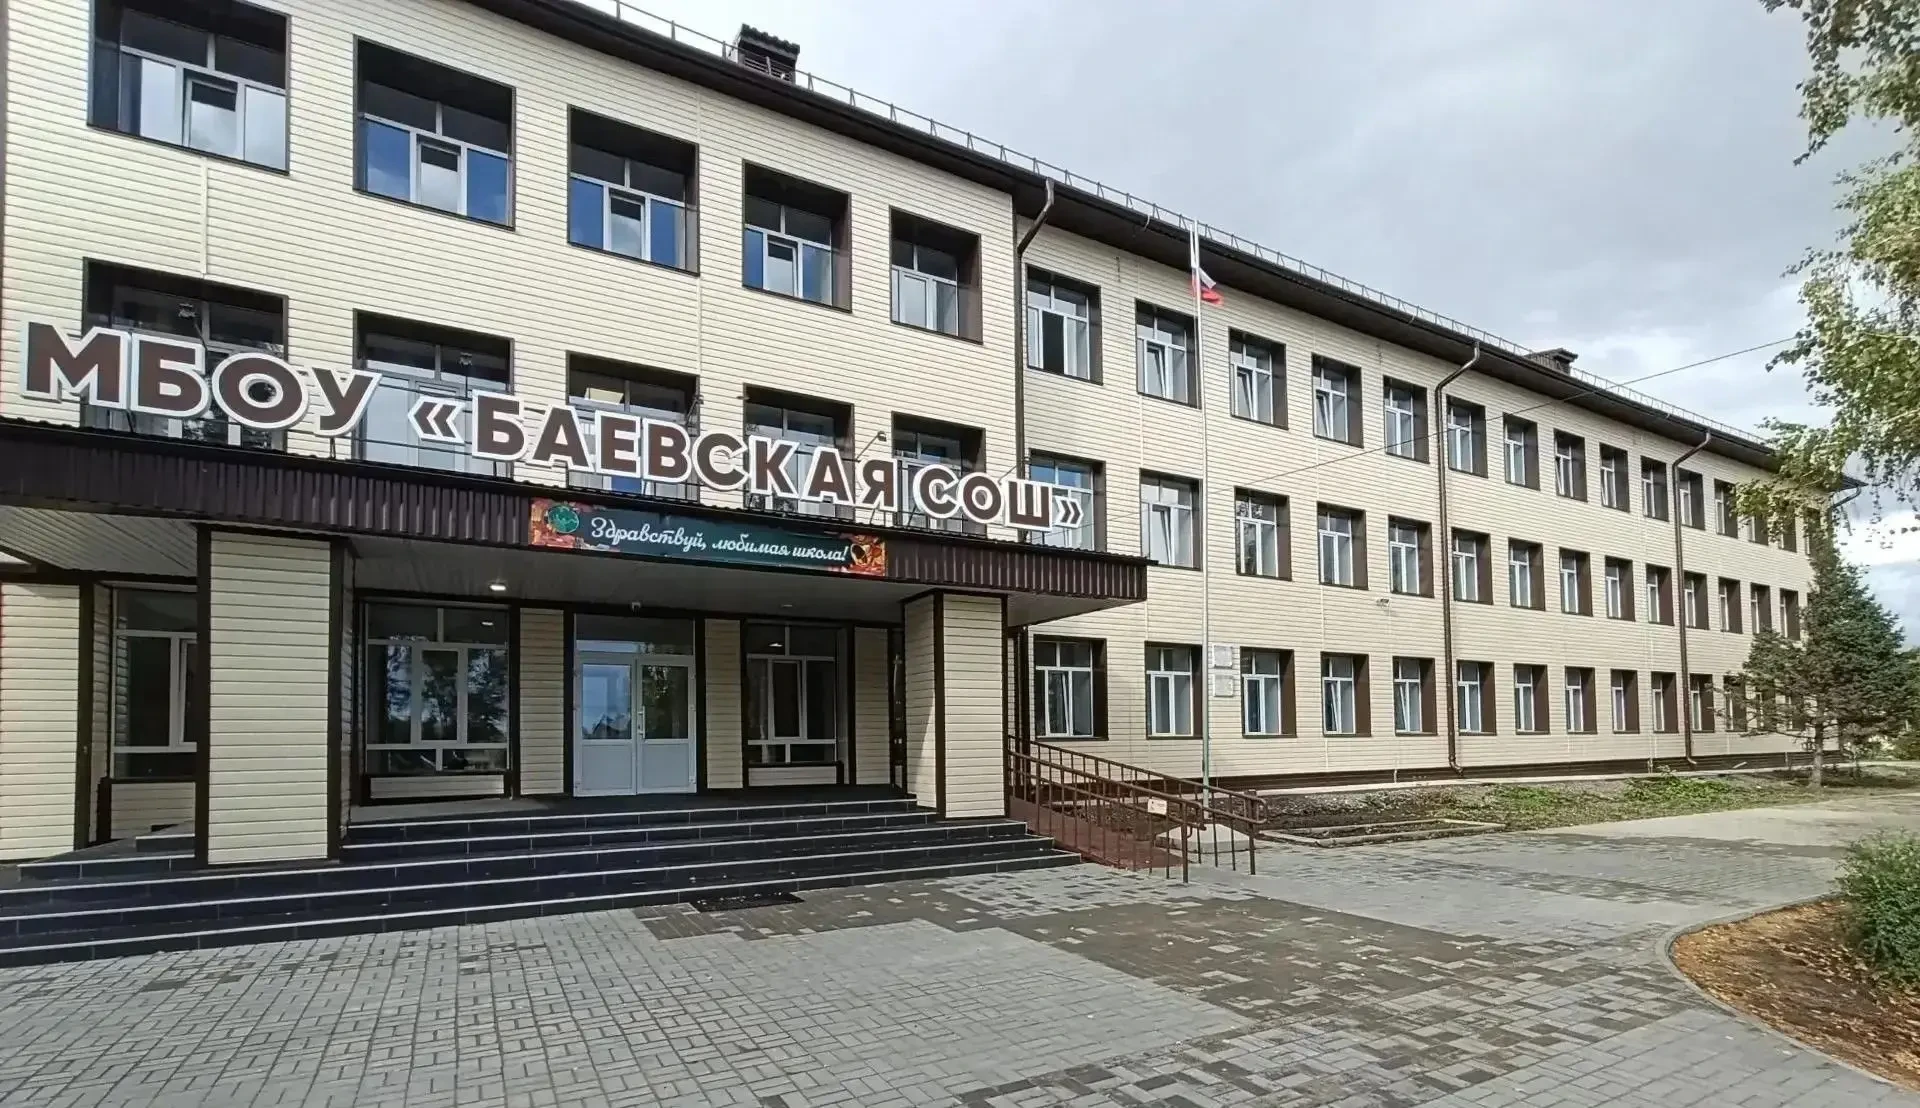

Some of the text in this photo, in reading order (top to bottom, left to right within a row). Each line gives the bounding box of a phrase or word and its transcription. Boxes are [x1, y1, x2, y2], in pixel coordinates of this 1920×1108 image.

[21, 318, 1084, 531] МБОУ «БАЕВСКАЯ СОШ»
[590, 516, 849, 562] Здравствуй, любимая школа!
